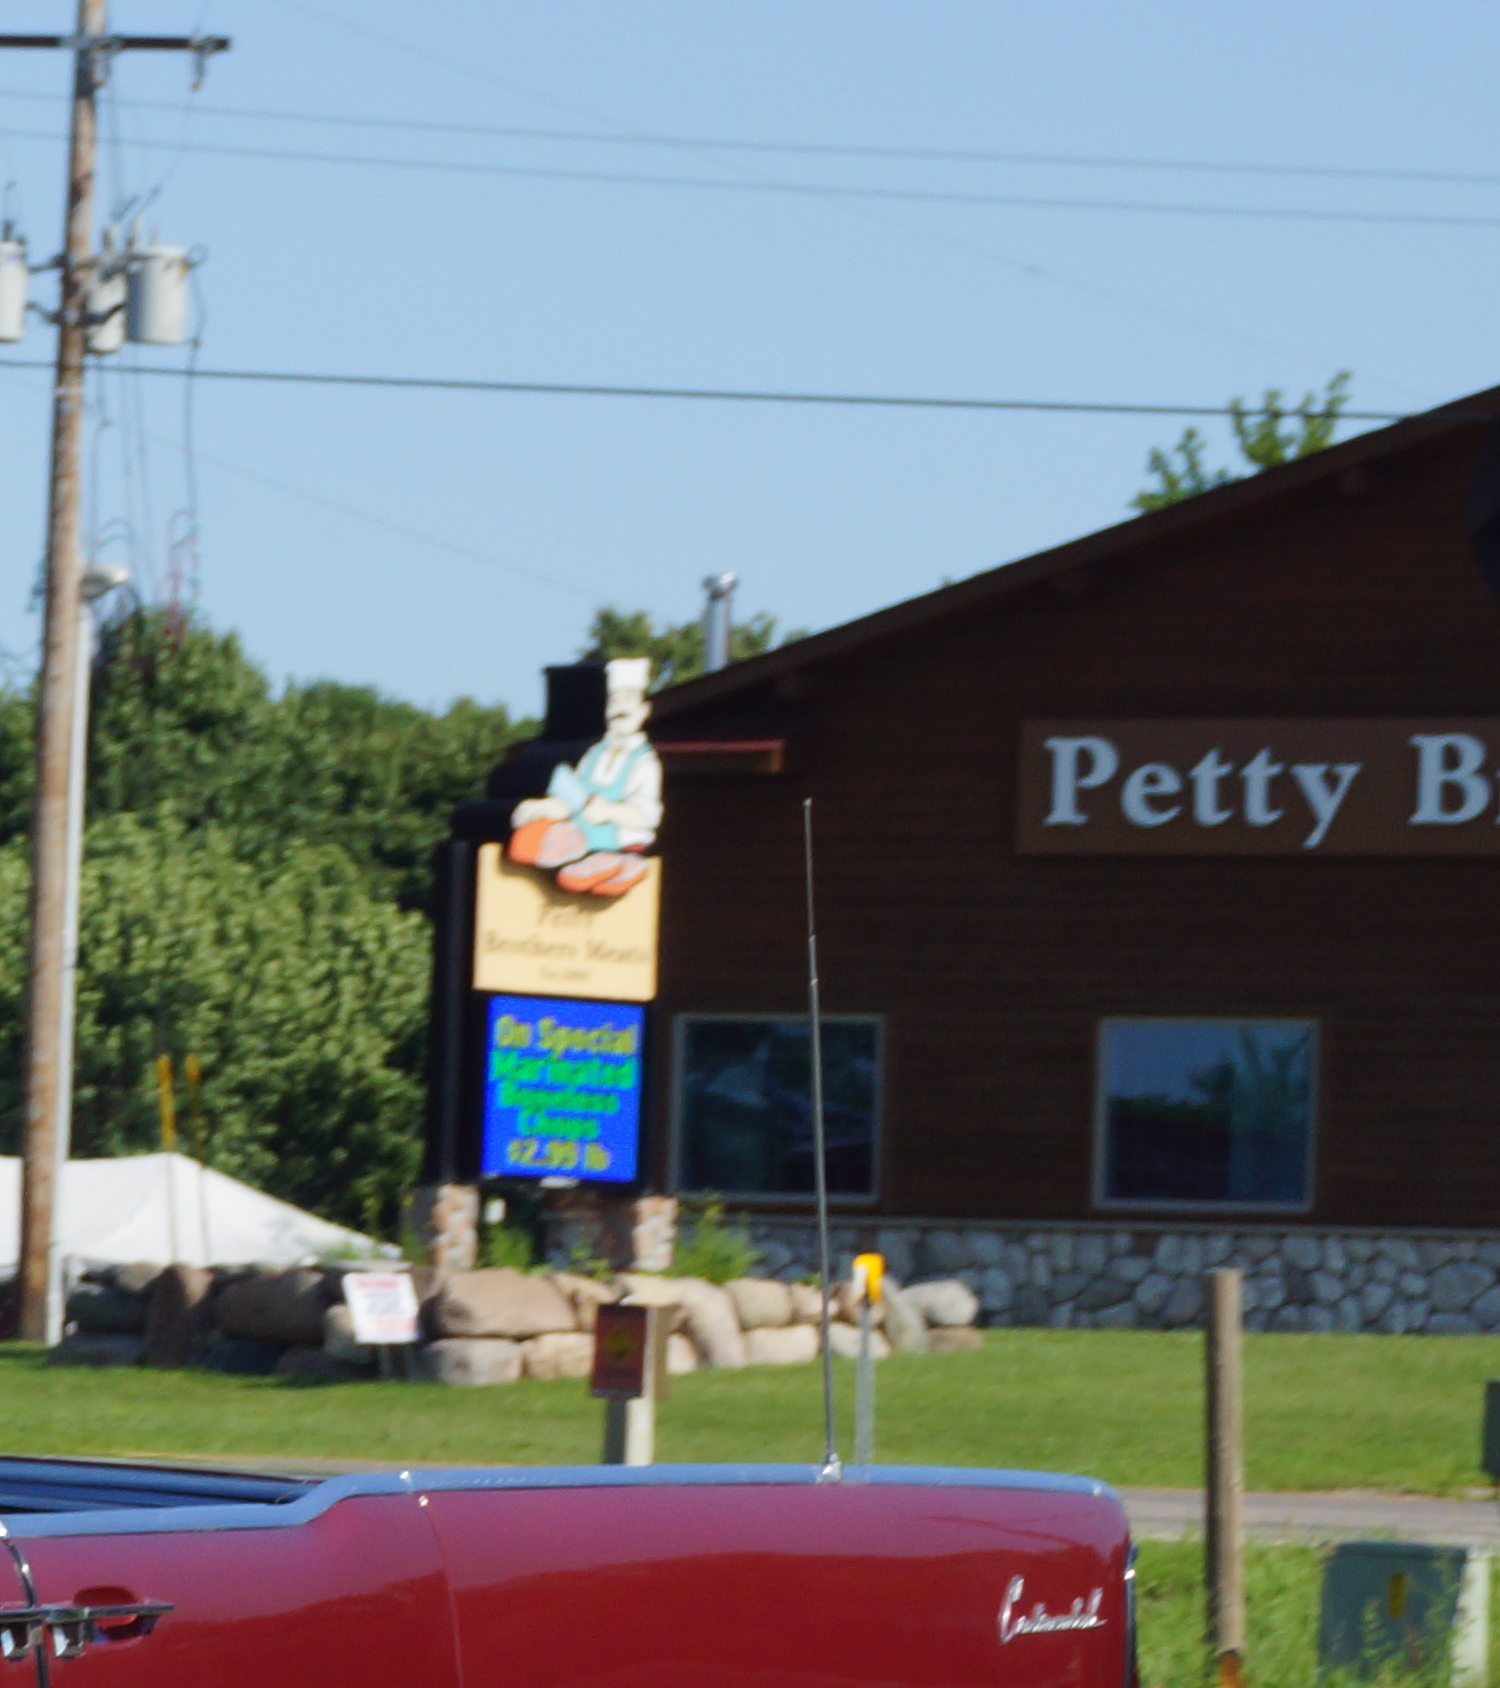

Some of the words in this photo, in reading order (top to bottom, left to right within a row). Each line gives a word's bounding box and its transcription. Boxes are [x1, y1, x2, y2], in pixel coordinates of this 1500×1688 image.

[1042, 735, 1364, 850] Petty
[1407, 732, 1500, 827] B
[495, 1015, 530, 1046] On
[538, 1017, 639, 1055] Special
[490, 1049, 638, 1088] Marinated
